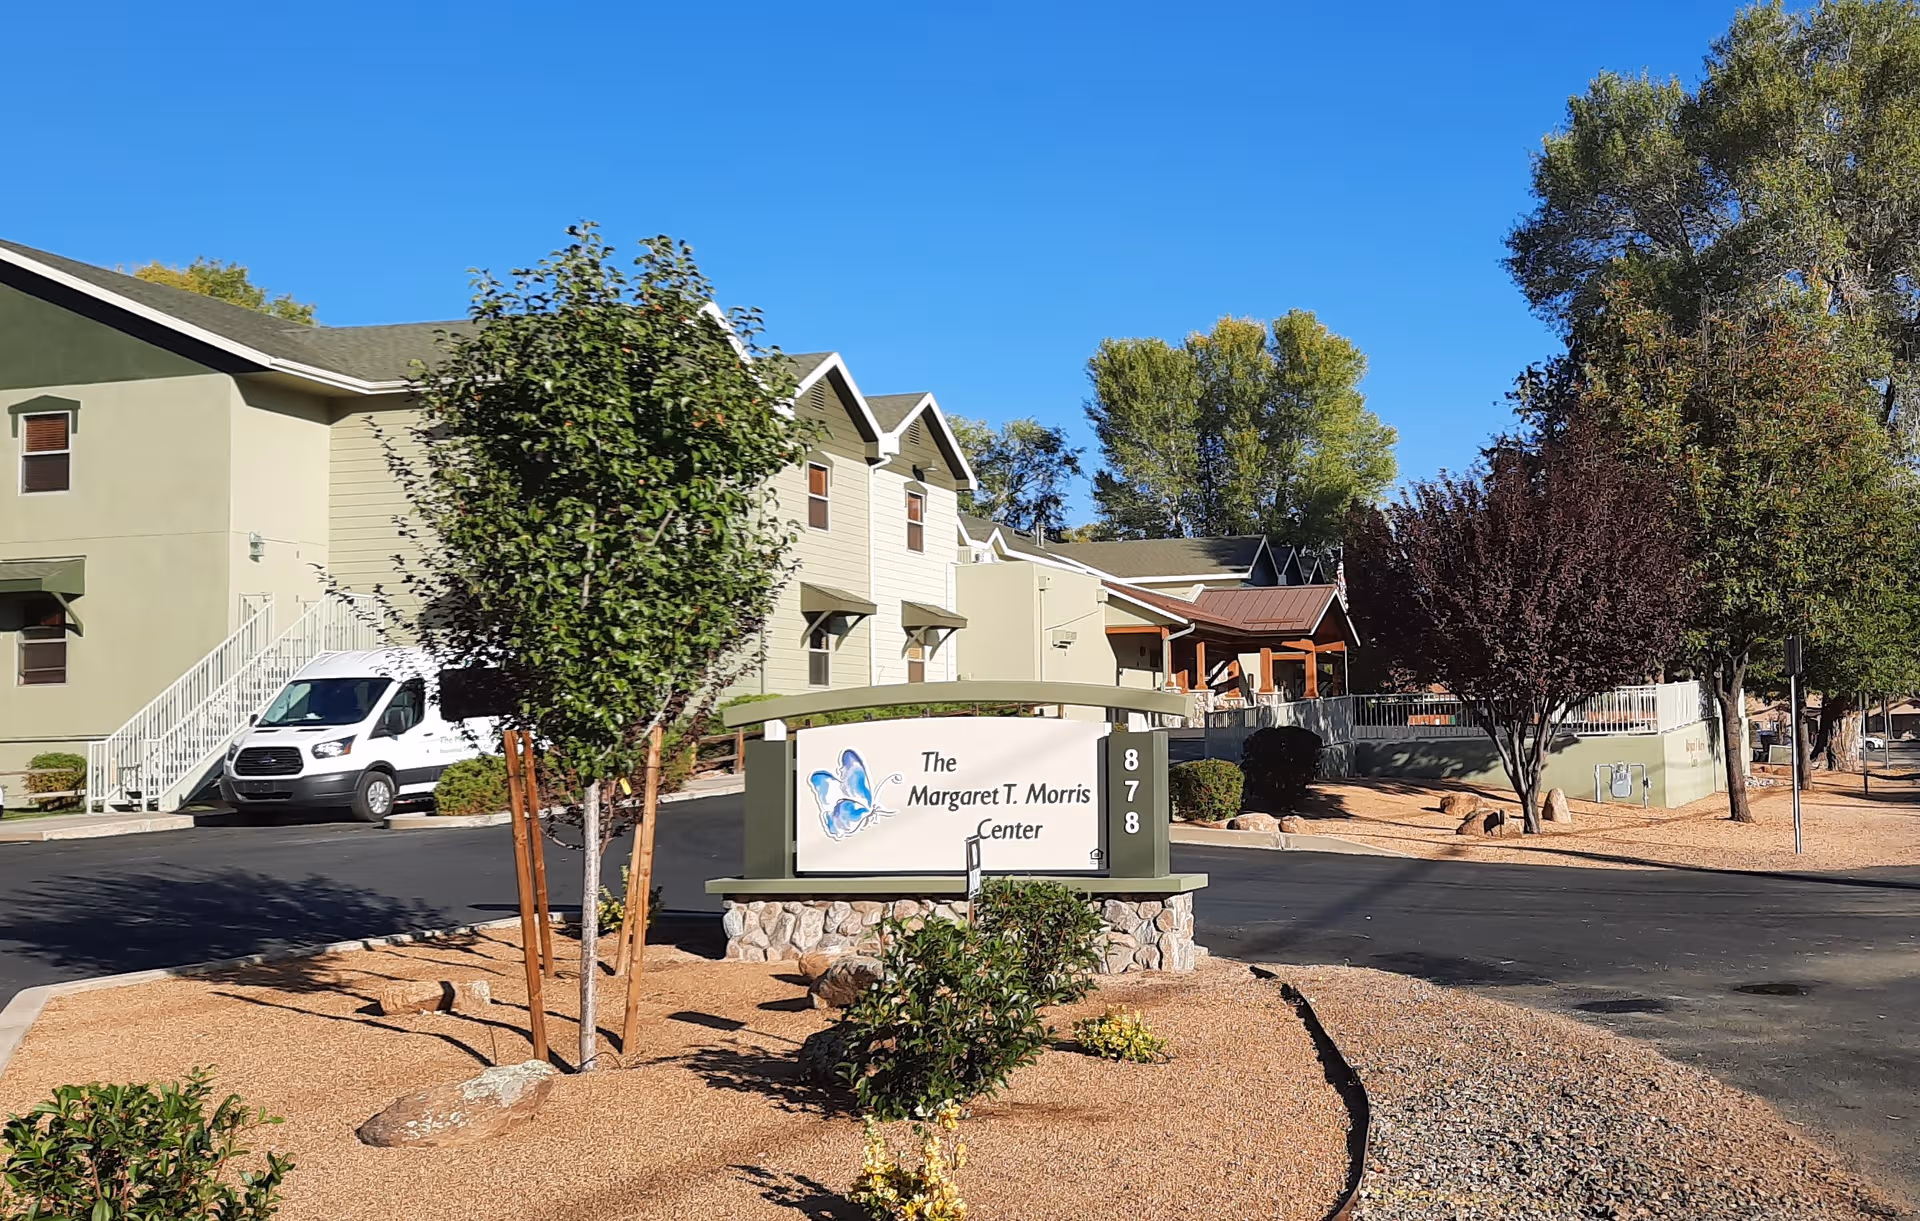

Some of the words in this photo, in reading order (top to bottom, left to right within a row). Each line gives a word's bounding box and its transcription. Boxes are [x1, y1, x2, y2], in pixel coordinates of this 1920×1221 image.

[922, 751, 957, 773] The
[907, 785, 1000, 812] Margaret
[1003, 783, 1018, 805] T.
[1025, 782, 1091, 805] Morris
[976, 818, 1044, 841] Center
